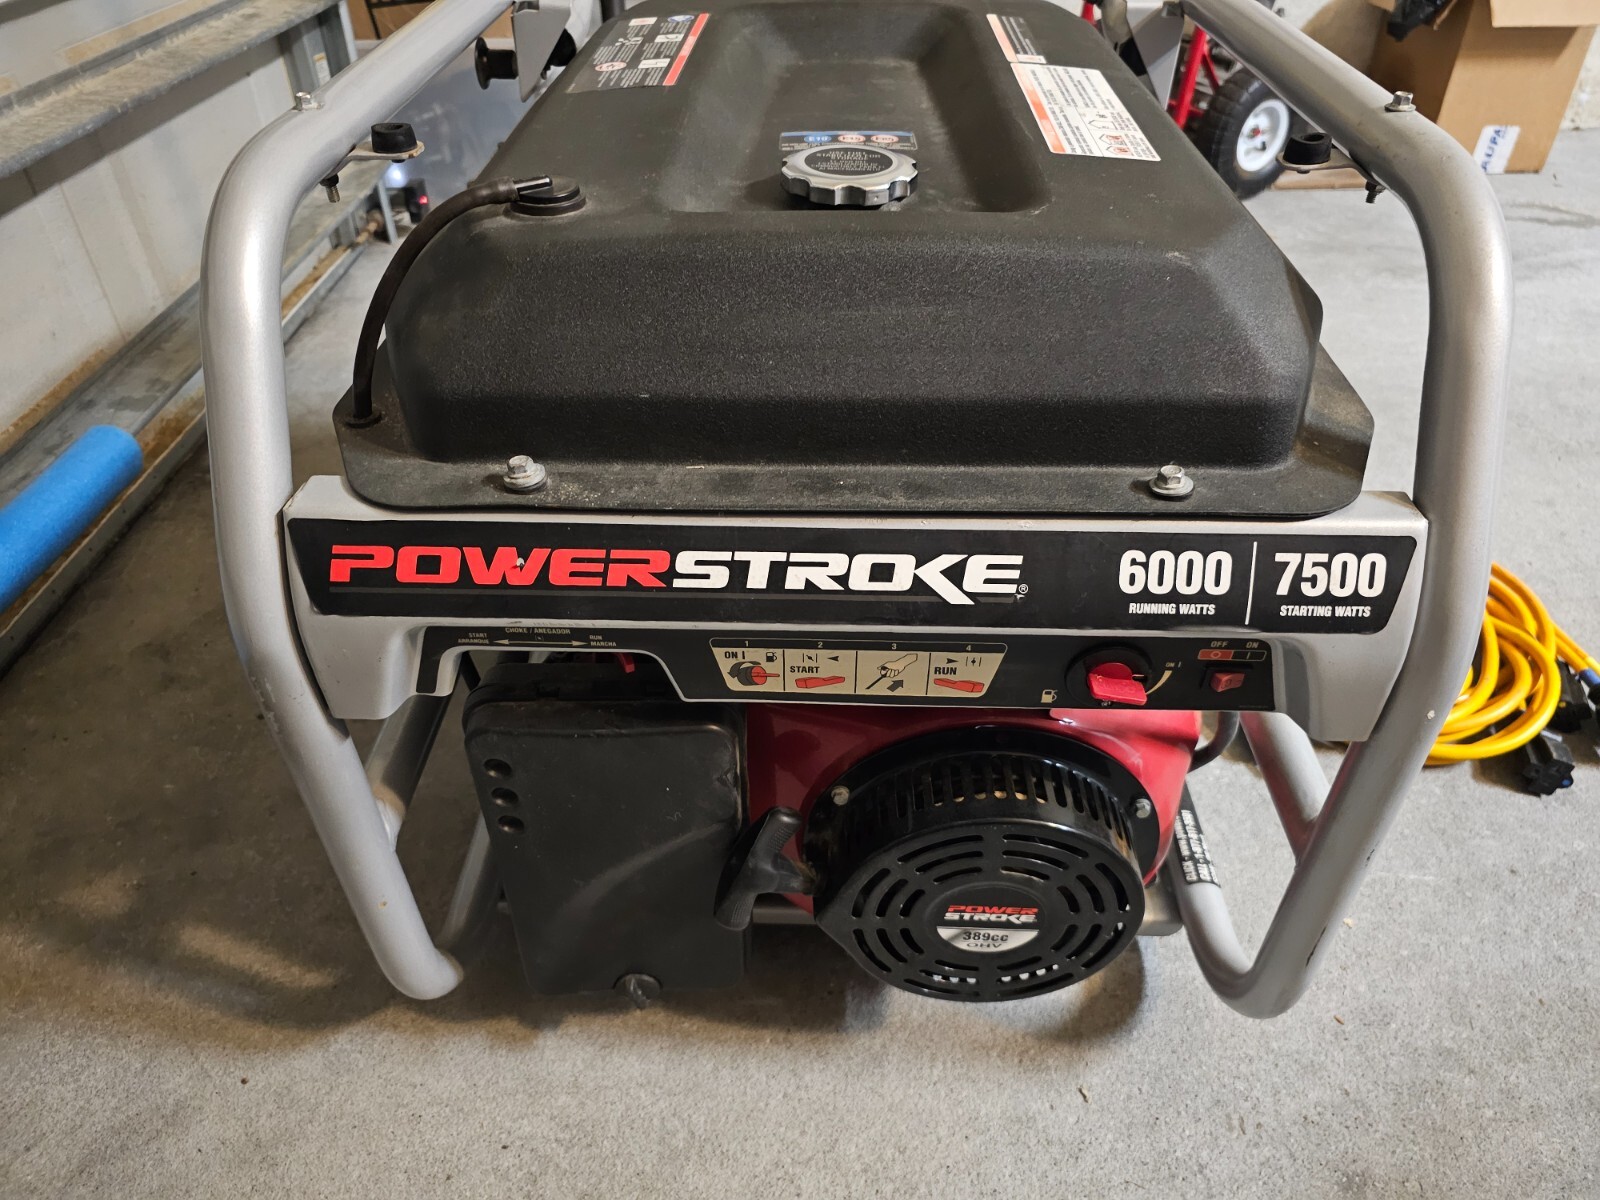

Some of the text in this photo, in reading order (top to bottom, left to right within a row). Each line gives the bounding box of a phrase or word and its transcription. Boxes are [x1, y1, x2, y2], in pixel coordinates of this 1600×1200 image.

[1118, 549, 1233, 596] 6000
[1274, 552, 1388, 598] 7500
[1128, 602, 1216, 615] RUNNING WATTS
[1279, 604, 1371, 618] STARTING WATTS
[1210, 640, 1228, 648] OFF
[724, 650, 738, 660] ON
[789, 665, 820, 675] START
[934, 666, 957, 676] RUN
[947, 905, 1038, 915] POWER
[943, 912, 1038, 924] STROKE
[962, 931, 1009, 942] 389cc
